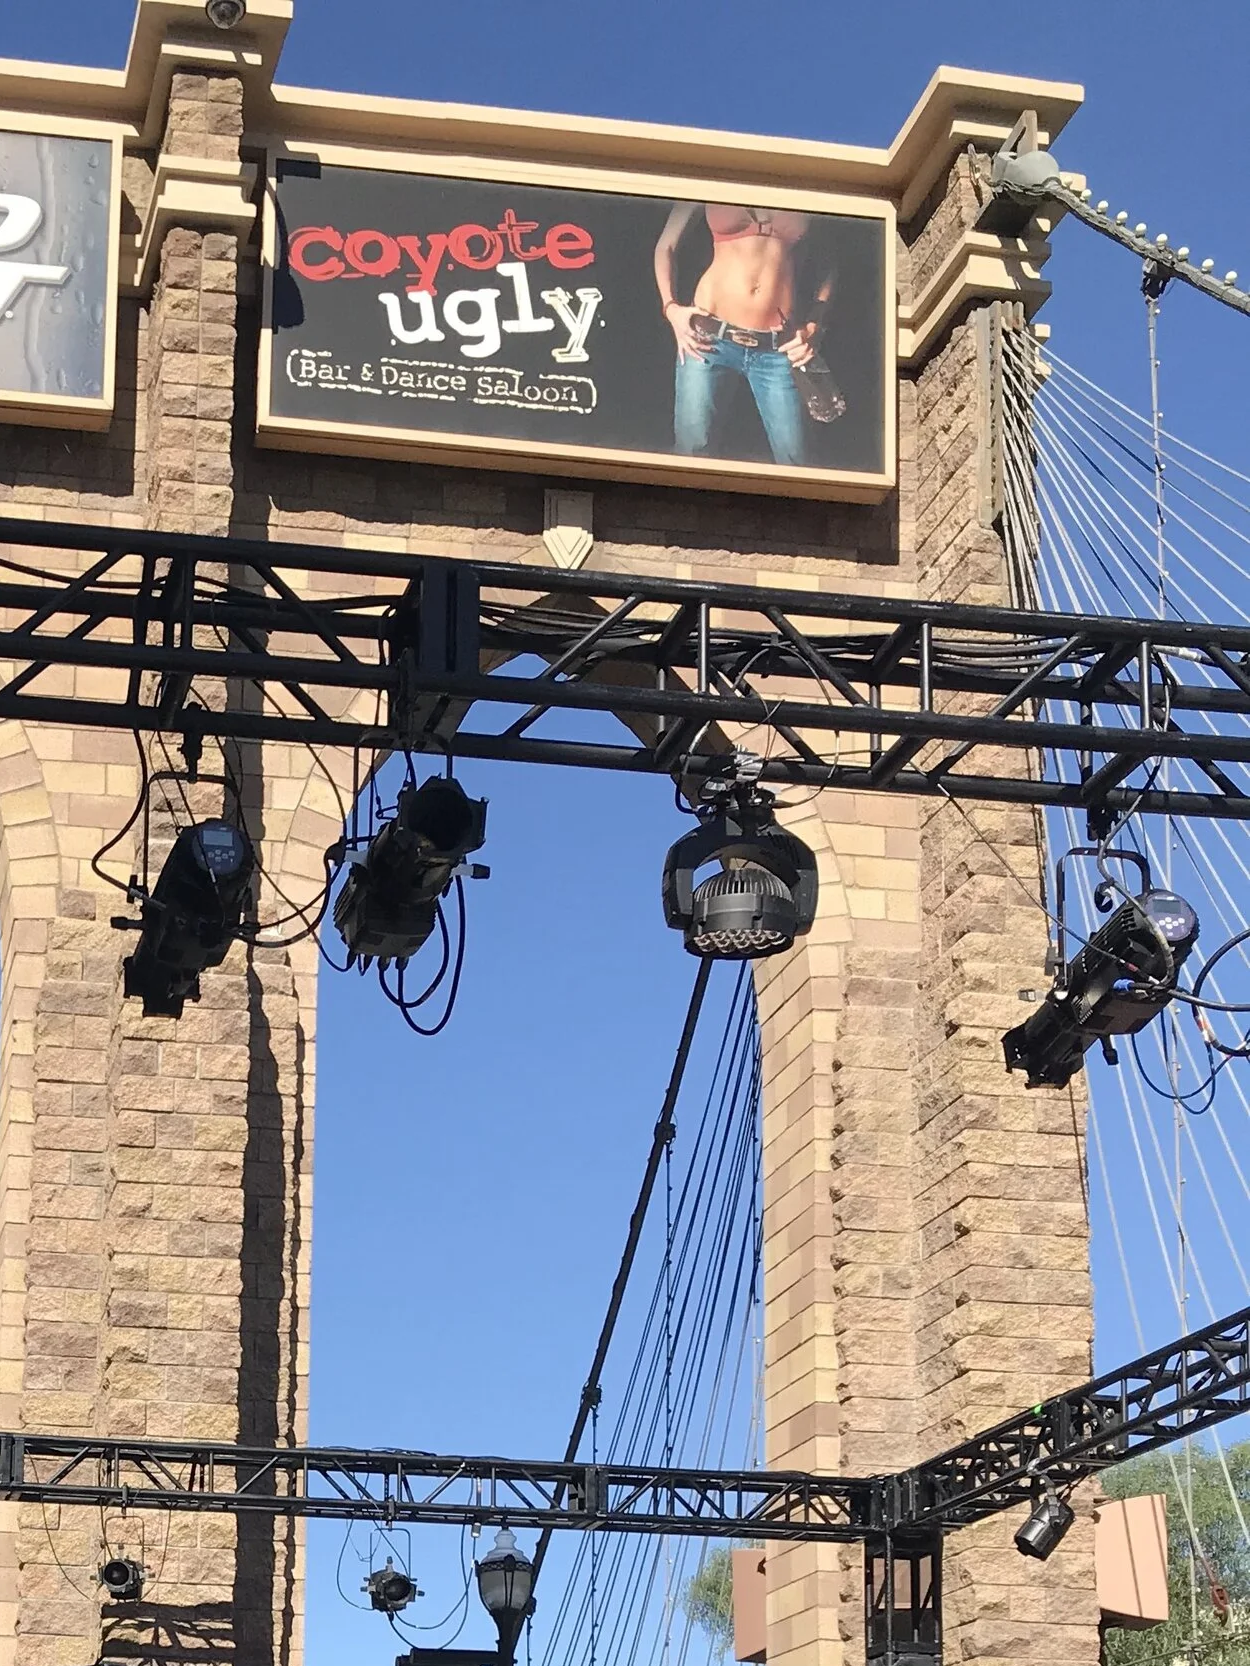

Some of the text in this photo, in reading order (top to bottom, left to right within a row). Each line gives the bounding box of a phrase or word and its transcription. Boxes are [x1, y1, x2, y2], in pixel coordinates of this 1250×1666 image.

[288, 208, 595, 295] coyote
[379, 262, 604, 362] ugly
[298, 356, 580, 404] Bar & Dance Saloon
